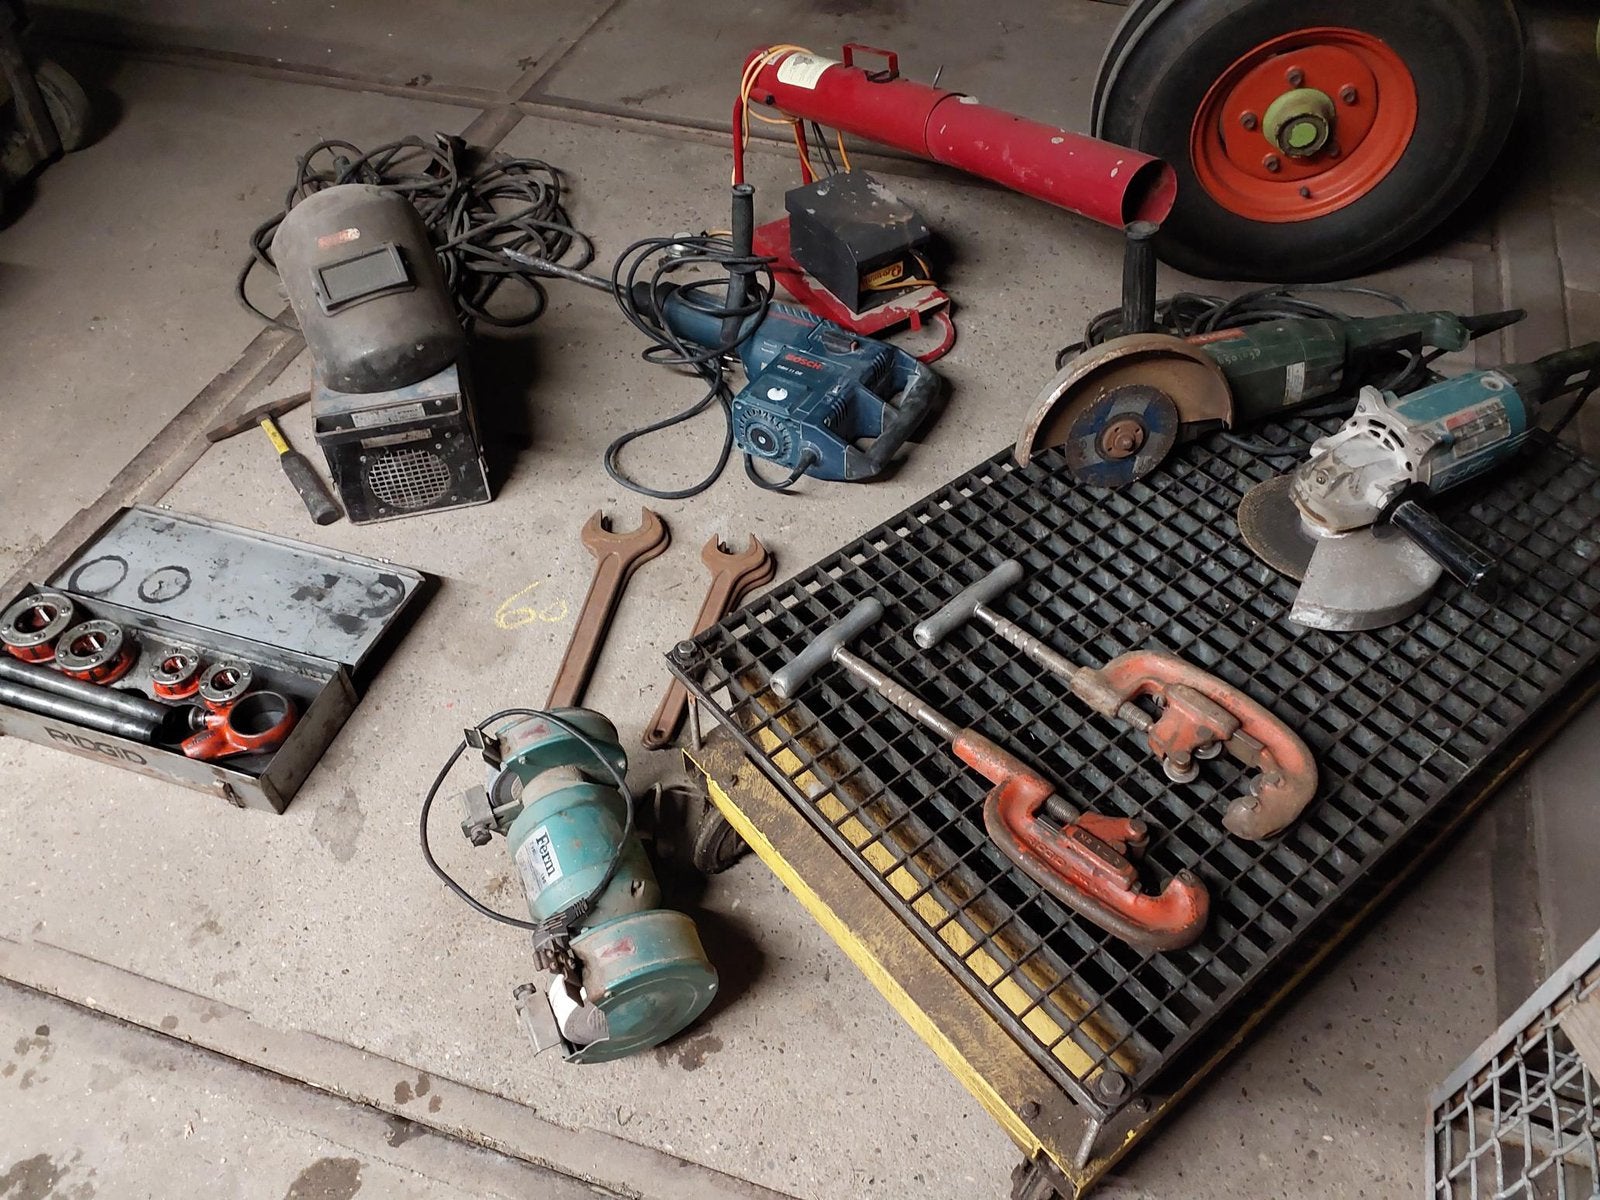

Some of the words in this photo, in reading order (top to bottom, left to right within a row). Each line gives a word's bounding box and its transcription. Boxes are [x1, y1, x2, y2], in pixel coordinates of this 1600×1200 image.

[785, 353, 823, 370] BOSCH
[43, 726, 147, 765] RIDGID
[536, 832, 556, 878] Ferm
